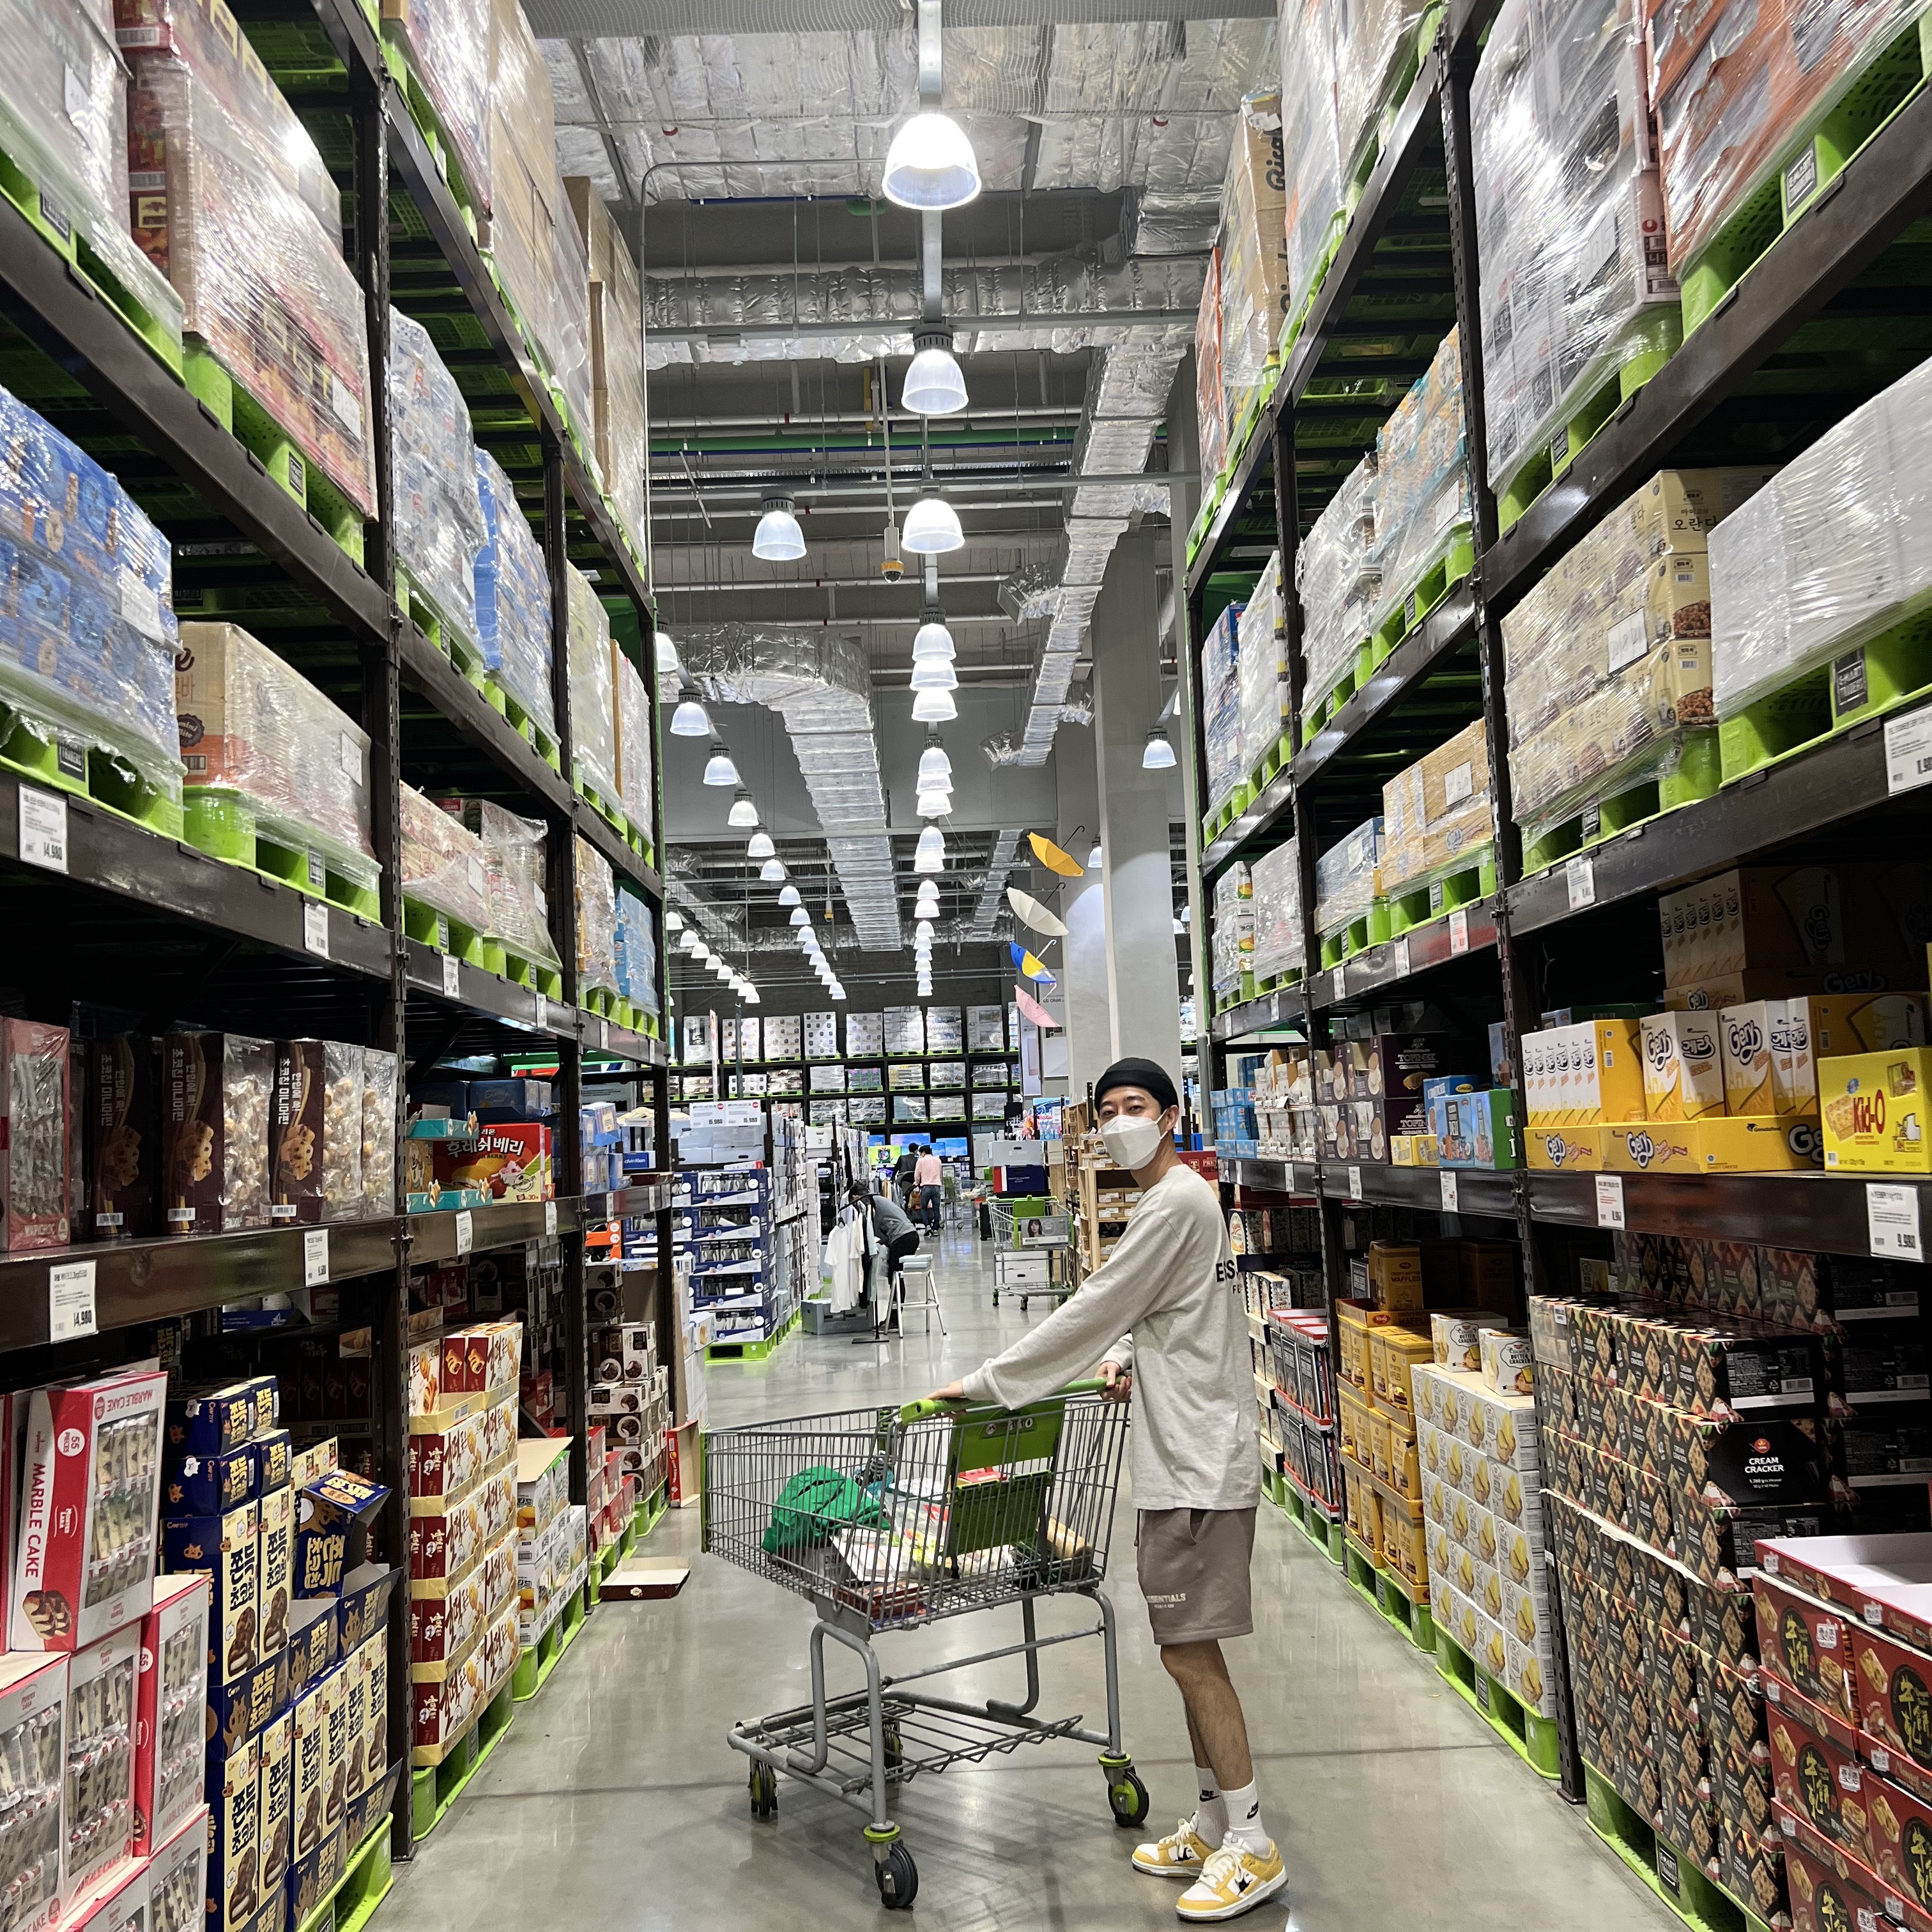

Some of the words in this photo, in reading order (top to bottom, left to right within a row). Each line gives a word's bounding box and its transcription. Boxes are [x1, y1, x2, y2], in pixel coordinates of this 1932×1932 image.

[1672, 517, 1719, 531] 오란다
[1646, 1029, 1673, 1071] Gery
[1728, 1020, 1763, 1066] Gery
[279, 1058, 290, 1087] 초코칩
[278, 1087, 289, 1124] 미니머핀
[1853, 1089, 1885, 1134] Kid-O
[447, 1136, 524, 1158] 후레쉬베리
[1545, 1133, 1566, 1168] Gery
[1626, 1130, 1654, 1169] Gery
[1398, 1317, 1430, 1326] WAFFLE
[127, 1388, 153, 1406] MARBLE
[71, 1435, 80, 1449] 55
[1749, 1456, 1779, 1465] CREAM
[1744, 1464, 1784, 1473] CRACKER
[29, 1463, 45, 1529] MARBLE
[26, 1533, 42, 1579] CAKE
[230, 1542, 254, 1583] 쫀득
[267, 1526, 287, 1563] 쫀득
[232, 1781, 256, 1828] 쫀득
